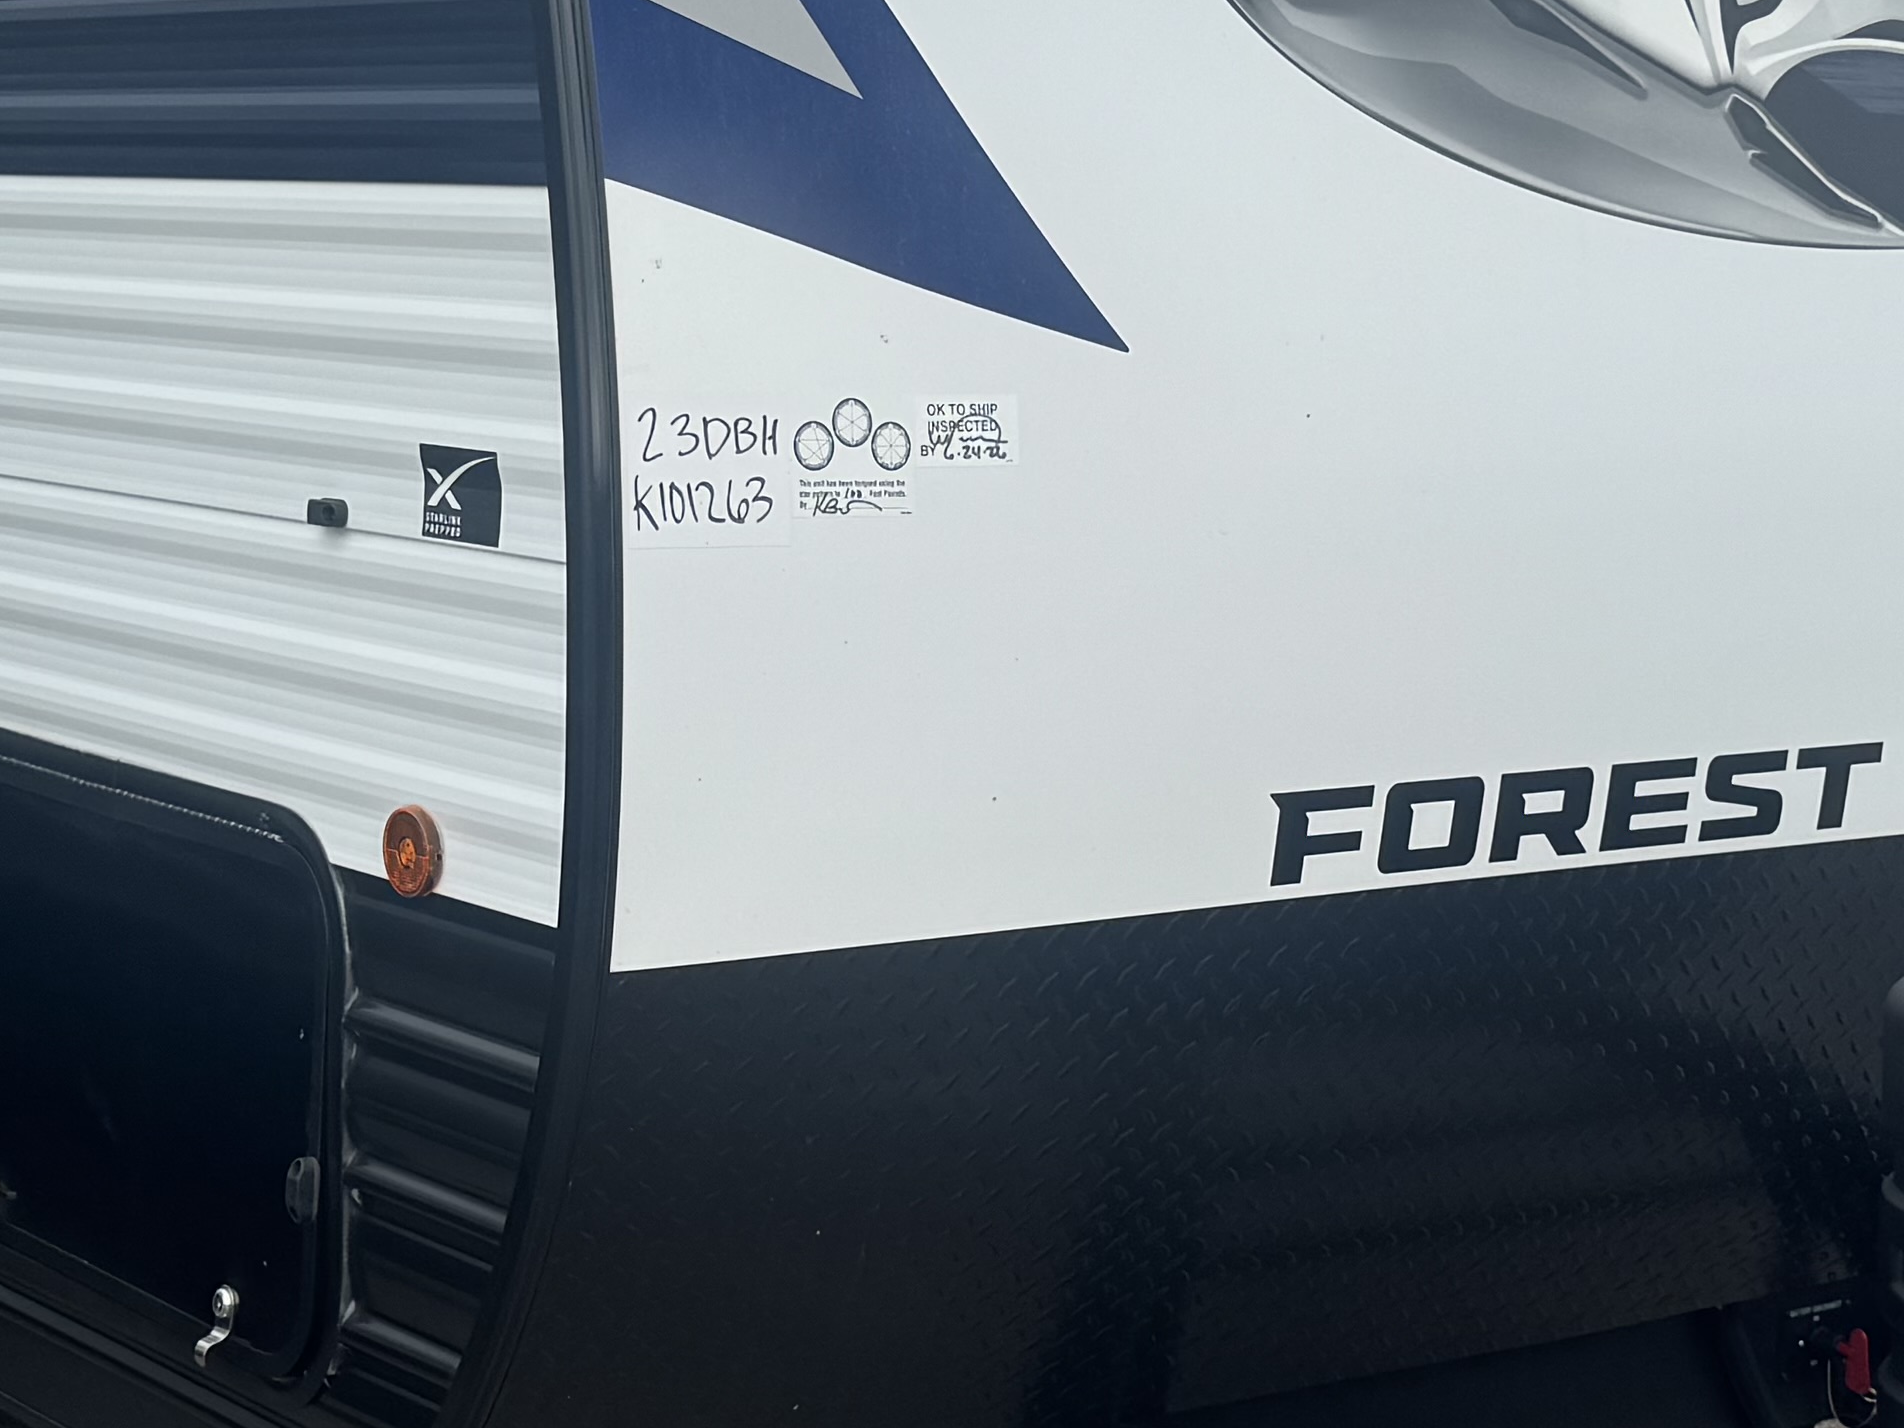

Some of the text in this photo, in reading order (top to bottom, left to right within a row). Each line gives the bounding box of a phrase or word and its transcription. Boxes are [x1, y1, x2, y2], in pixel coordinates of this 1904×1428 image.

[926, 403, 998, 417] OK TO SHIP
[928, 419, 998, 433] INSPECTED
[636, 407, 779, 463] 23DBH
[920, 444, 935, 457] BY
[633, 474, 775, 532] K101263
[1269, 741, 1884, 886] FOREST
